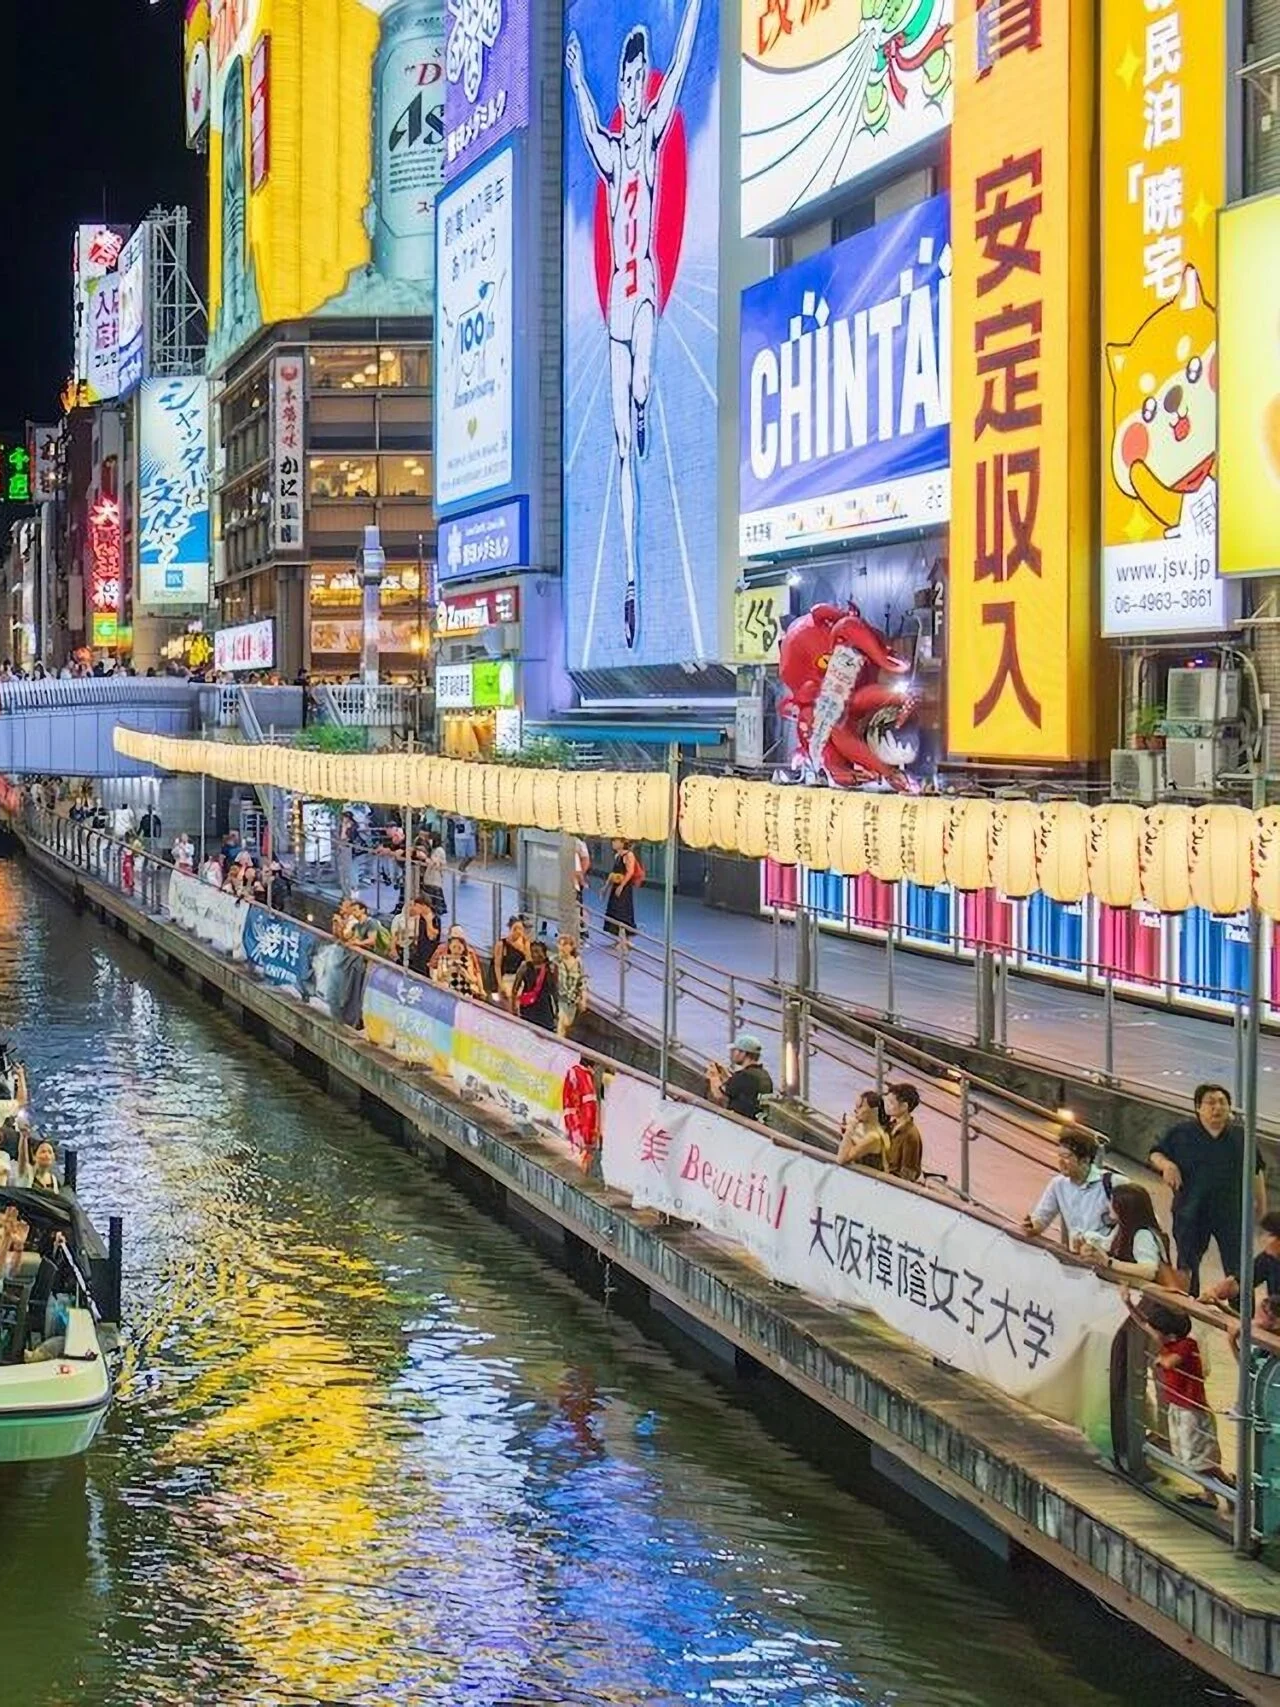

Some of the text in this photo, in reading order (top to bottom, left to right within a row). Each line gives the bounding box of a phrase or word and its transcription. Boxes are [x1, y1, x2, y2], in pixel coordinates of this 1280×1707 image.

[974, 148, 1042, 729] 安定収入
[1115, 589, 1213, 614] 06-4963-3661
[1116, 553, 1210, 584] www.jsv.jp
[809, 1207, 1055, 1369] 大阪樟蔭女子大学
